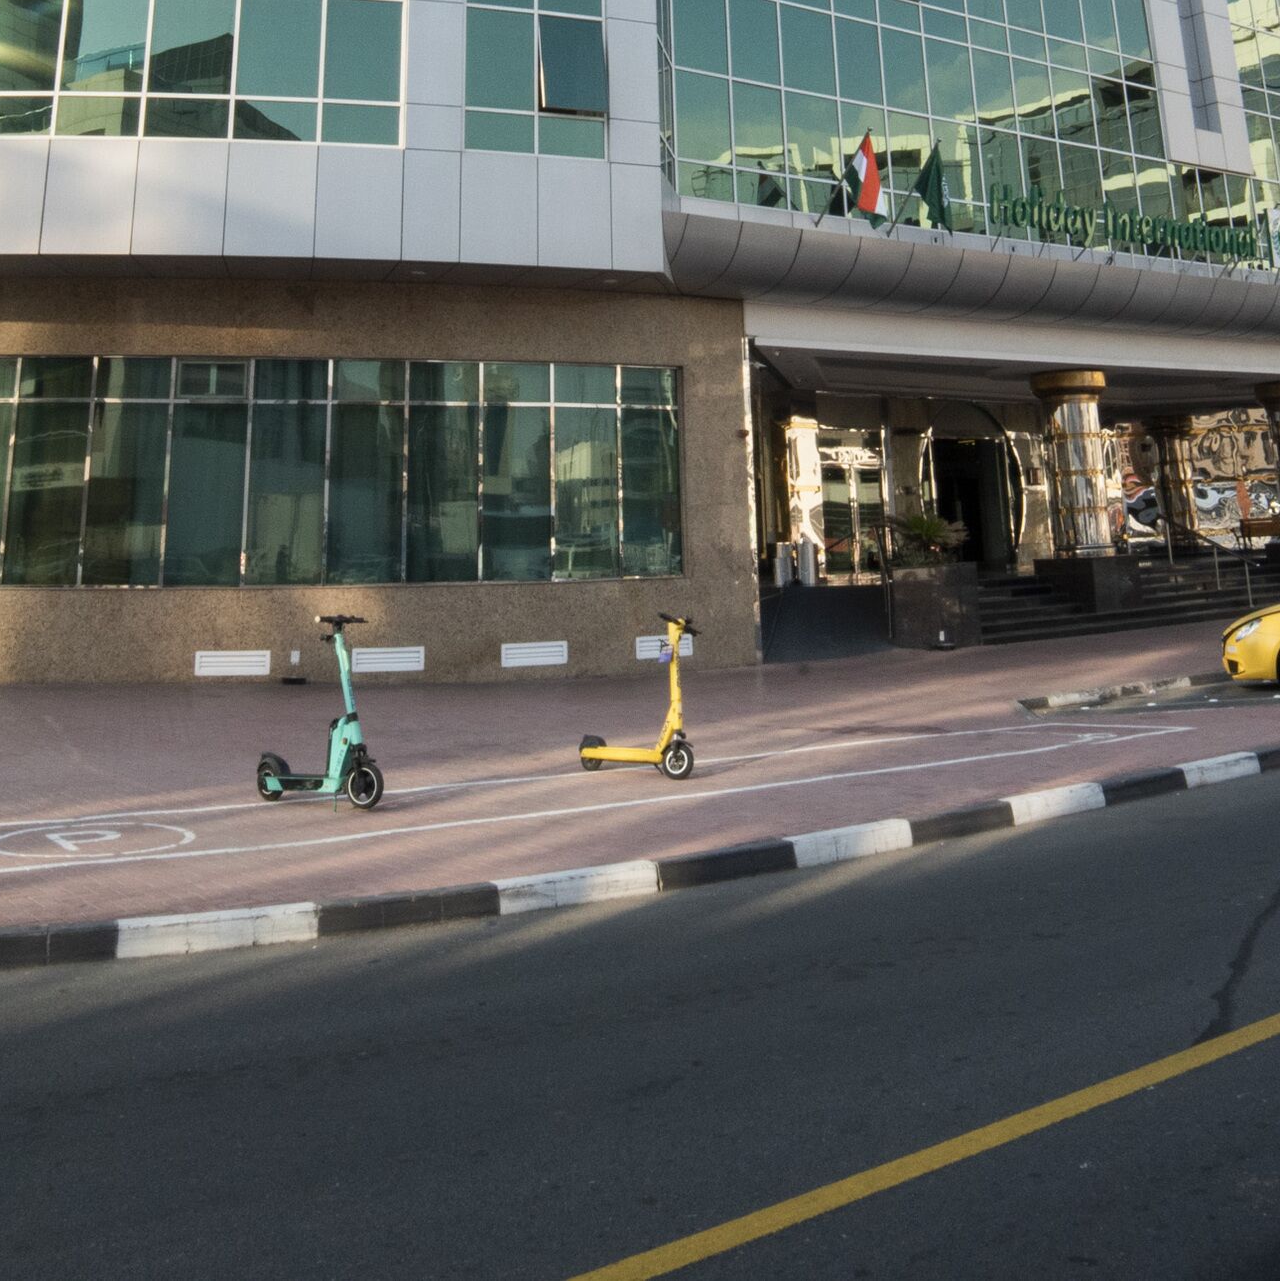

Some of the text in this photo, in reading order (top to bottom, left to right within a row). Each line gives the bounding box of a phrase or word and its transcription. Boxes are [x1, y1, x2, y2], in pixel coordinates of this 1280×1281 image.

[989, 181, 1258, 257] Holiday International
[44, 829, 122, 852] P
